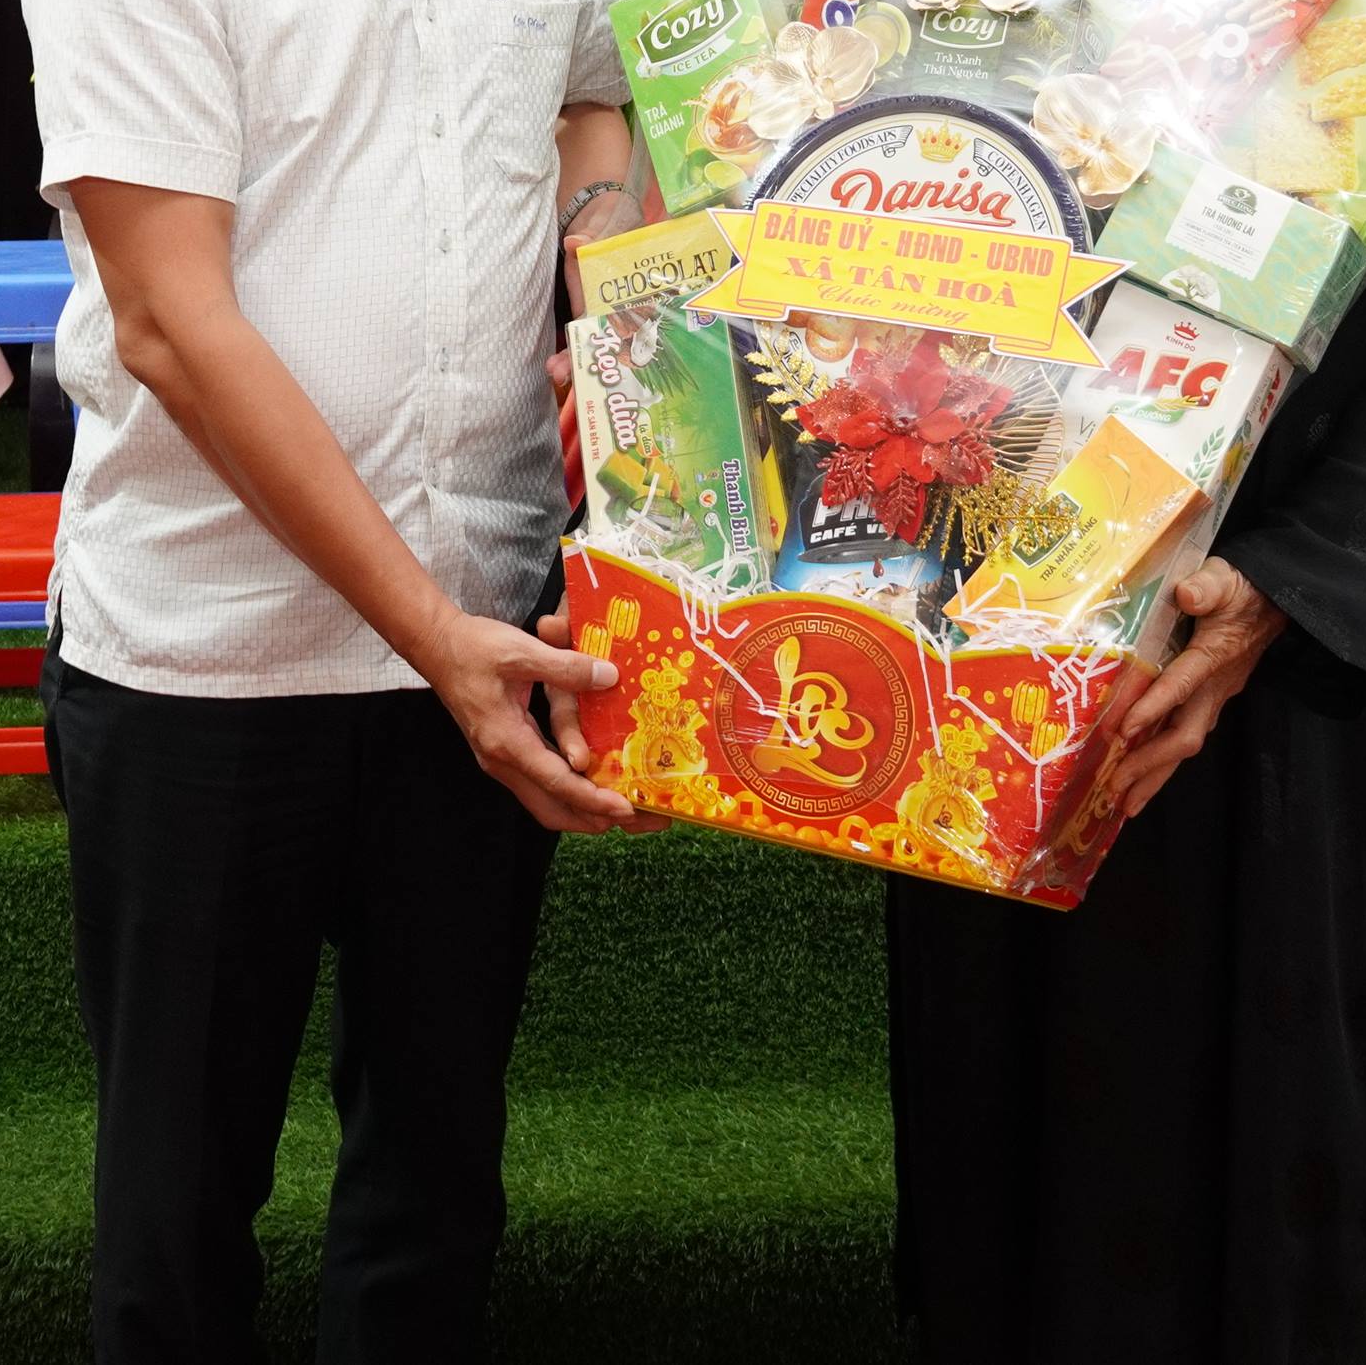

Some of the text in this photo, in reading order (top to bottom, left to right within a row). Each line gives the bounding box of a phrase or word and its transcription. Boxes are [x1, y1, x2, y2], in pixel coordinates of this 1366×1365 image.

[932, 11, 996, 41] Cozy
[672, 48, 718, 73] ICE TEA
[923, 63, 989, 81] Thái Nguyên
[935, 51, 982, 67] Trà Xanh
[644, 100, 668, 123] TRÀ
[649, 113, 685, 139] CHANH
[790, 154, 839, 204] PECIALITY
[837, 137, 876, 161] FOODS
[987, 151, 1047, 231] COPENHAGEN
[830, 167, 1016, 221] Danisa
[634, 250, 675, 270] LOTTE
[763, 209, 832, 247] ĐẢNG
[838, 217, 874, 253] UỶ
[895, 230, 964, 265] HĐND
[986, 242, 1055, 277] UBND
[598, 248, 719, 304] CHOCOLAT
[782, 255, 1019, 308] XÃ TÂN HOÀ
[817, 283, 972, 326] Chúc mừng
[1166, 335, 1184, 347] KINH
[589, 327, 638, 450] Kẹo dừa
[1086, 346, 1230, 408] AFC
[723, 458, 747, 515] Thanh
[810, 522, 857, 544] CAFÉ
[1039, 564, 1057, 582] TRÀ
[1055, 540, 1078, 566] NHÃN
